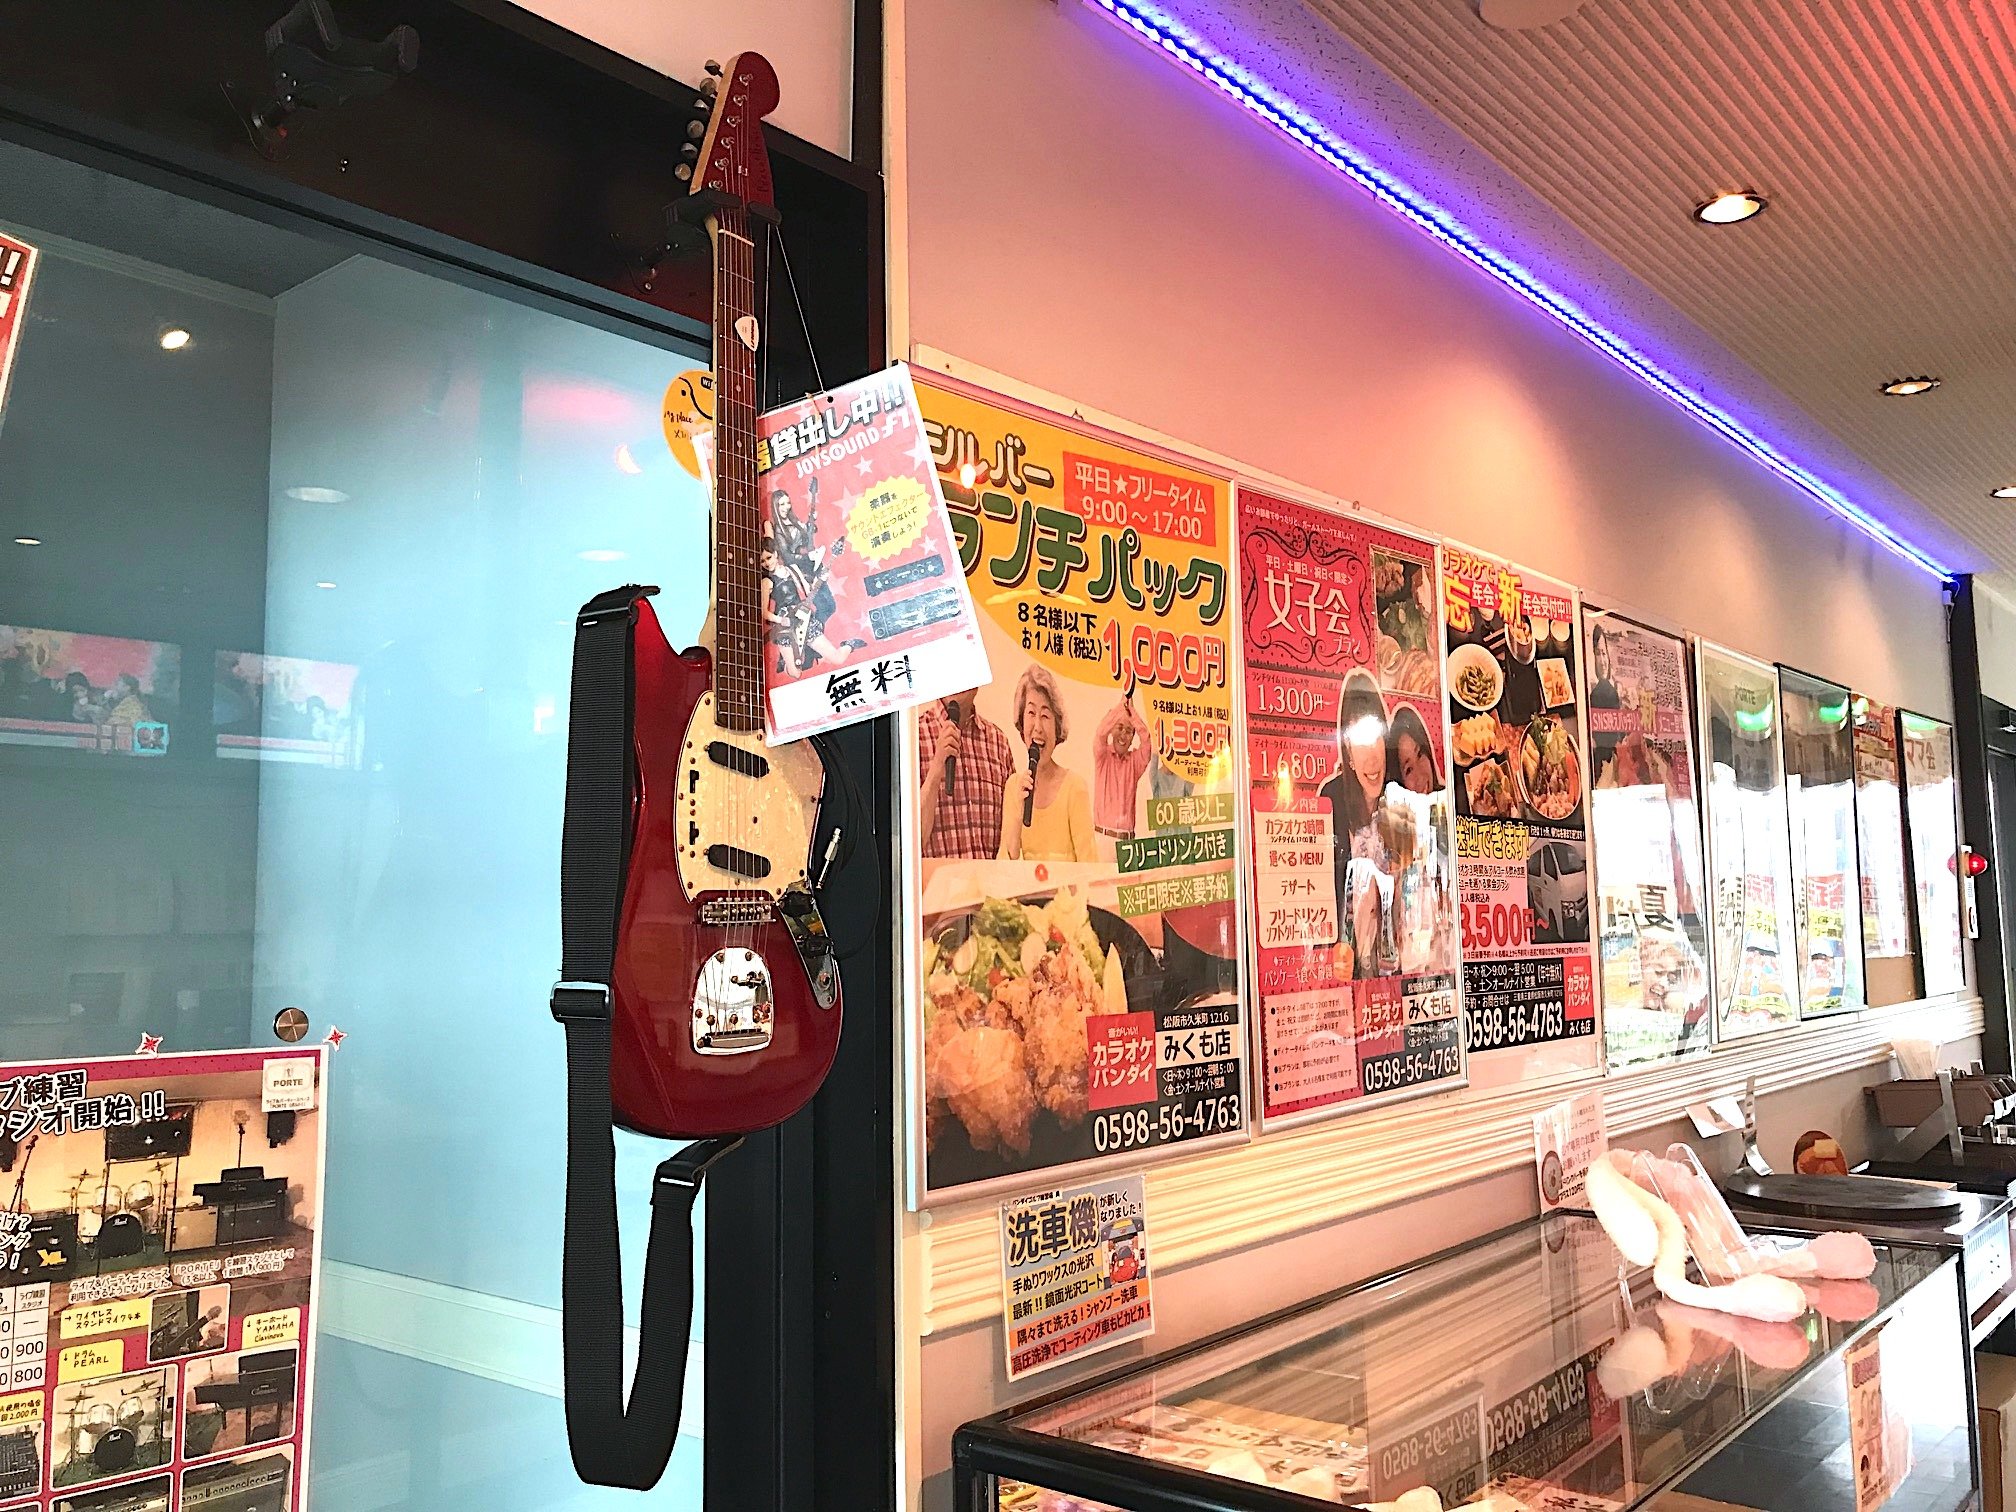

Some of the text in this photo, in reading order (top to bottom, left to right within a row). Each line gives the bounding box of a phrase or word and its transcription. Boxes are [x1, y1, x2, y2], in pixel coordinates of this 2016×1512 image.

[796, 427, 880, 479] JOYSOUND
[1263, 568, 1351, 637] 女子会
[1103, 619, 1226, 699] 1,000円
[1155, 716, 1231, 761] 1,300円
[1261, 750, 1327, 780] 1,680円
[1266, 819, 1325, 836] カラオケ3時間
[1121, 832, 1227, 868] フリードリンク付き
[1300, 852, 1324, 866] MENU
[1281, 879, 1316, 896] デザート
[1270, 907, 1328, 926] フリードリンク
[1567, 974, 1591, 992] カラオケ
[1408, 994, 1451, 1020] みくも店
[1567, 991, 1591, 1007] バンダイ
[1210, 1011, 1229, 1024] 1216
[1362, 1000, 1401, 1024] カラオケ
[1465, 1000, 1563, 1050] 0598-56-4763
[1568, 1019, 1591, 1036] みくも店
[1092, 1036, 1154, 1067] カラオケ
[1164, 1029, 1231, 1062] みくも店
[1092, 1062, 1153, 1089] バンダイ
[1365, 1046, 1459, 1091] 0598-56-4763
[273, 1078, 304, 1087] PORTE
[1094, 1095, 1241, 1152] 0598-56-4763
[1100, 1190, 1129, 1208] が新しく
[1100, 1202, 1142, 1223] なりました!
[1008, 1196, 1097, 1264] 洗車機
[1012, 1253, 1095, 1295] 手ぬりワックスの光沢
[255, 1321, 294, 1334] YAMAHA
[16, 1340, 44, 1358] 900
[74, 1351, 95, 1360] ドラム
[74, 1357, 110, 1368] PEARL
[14, 1366, 43, 1384] 800
